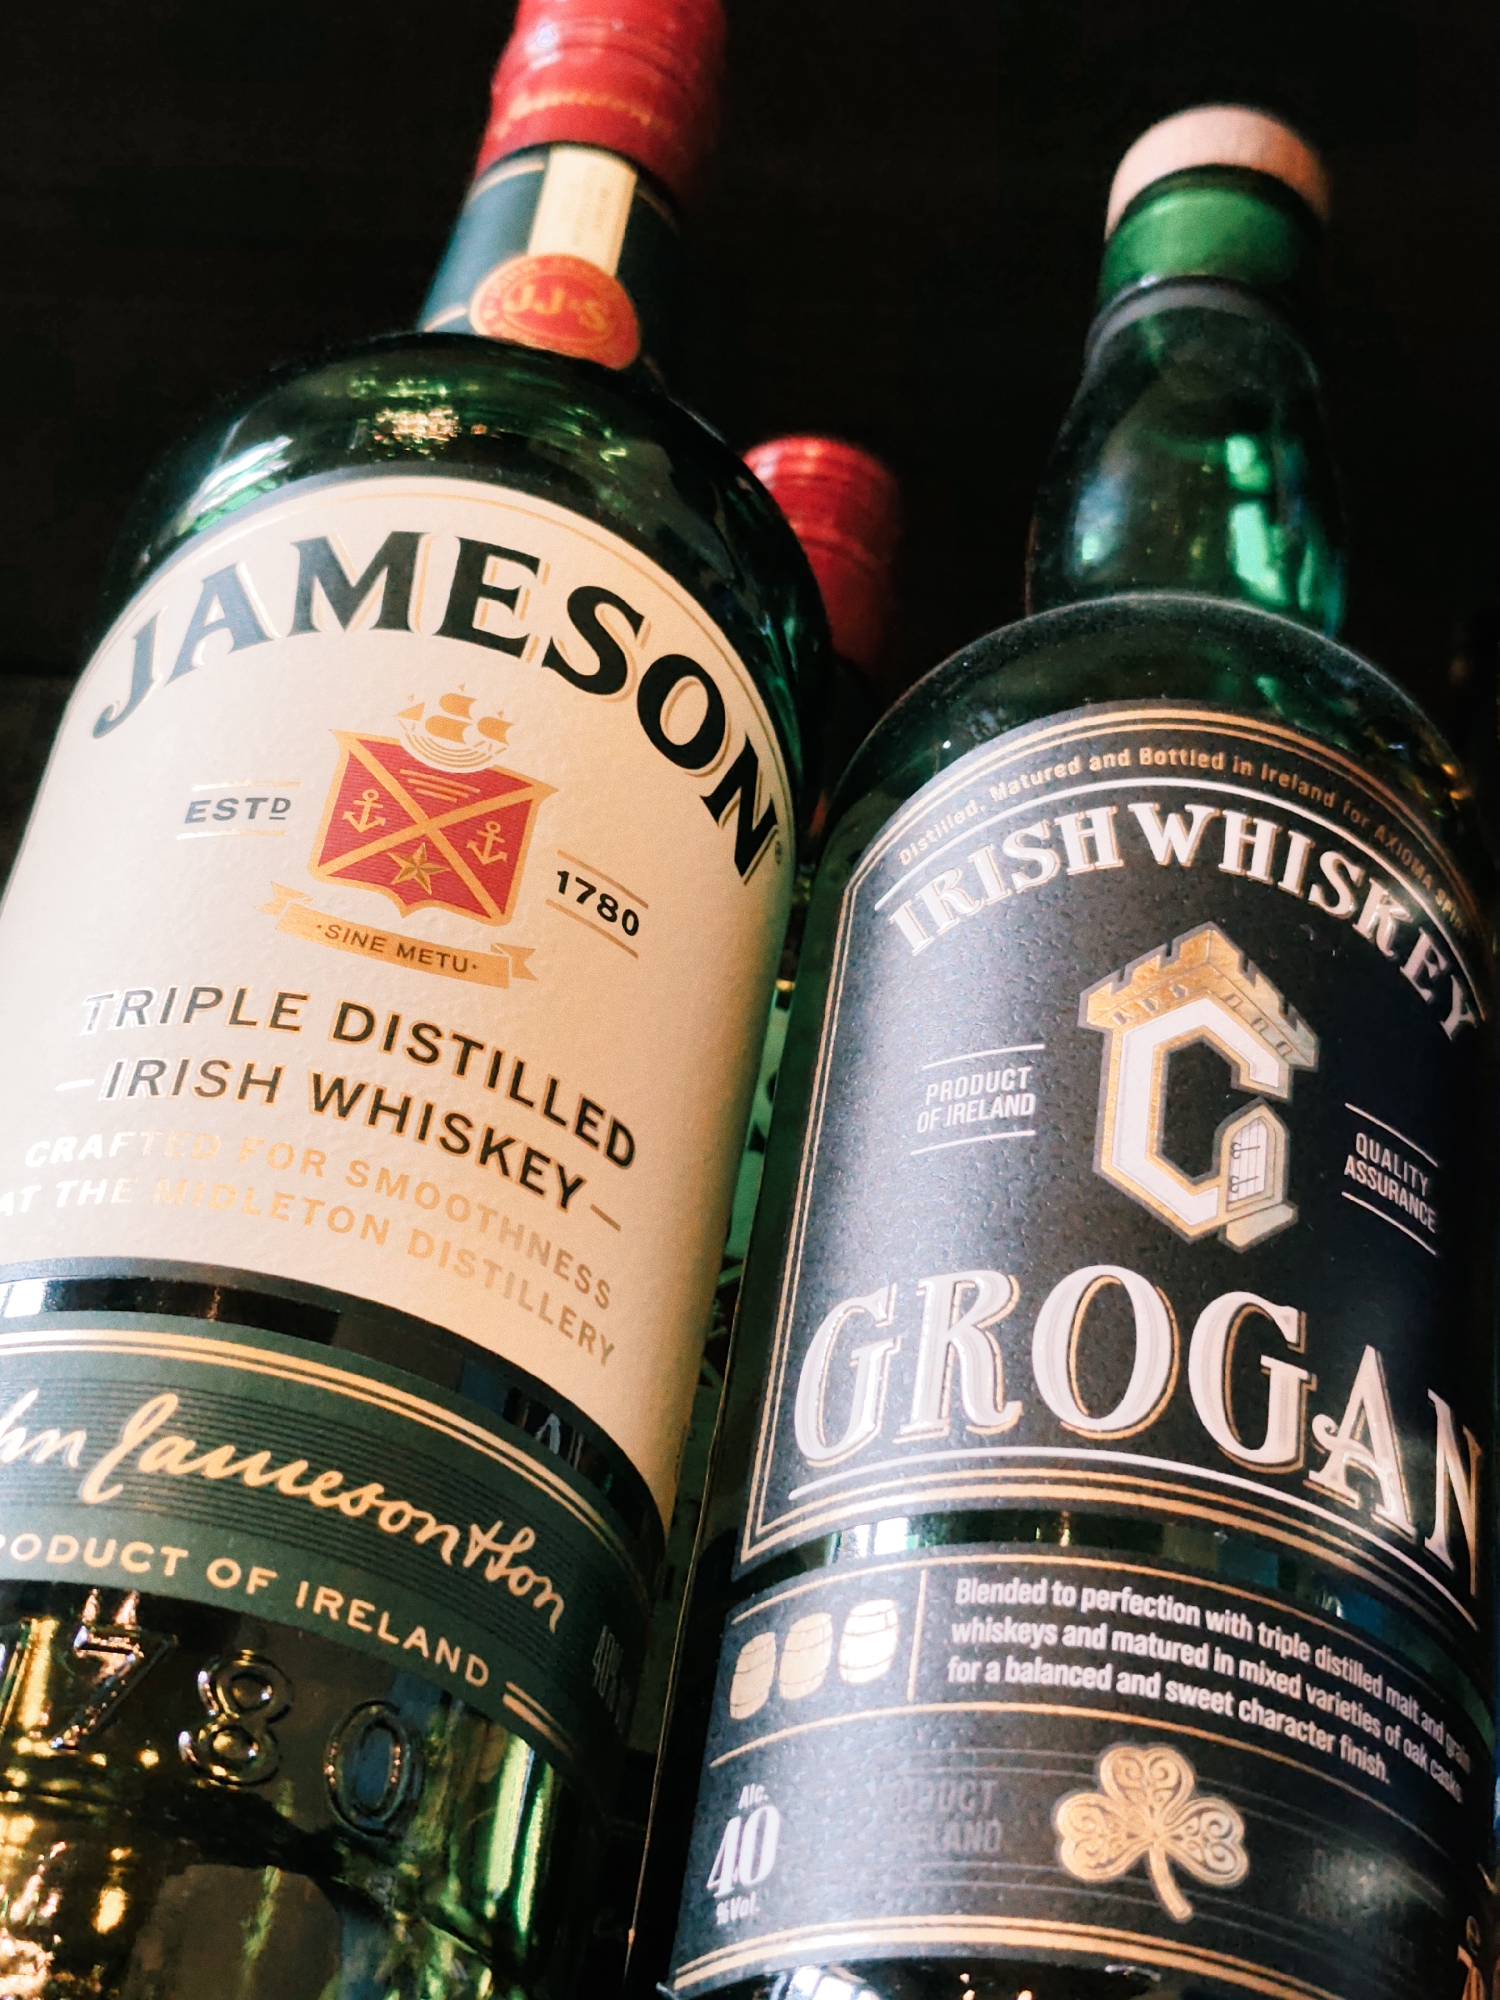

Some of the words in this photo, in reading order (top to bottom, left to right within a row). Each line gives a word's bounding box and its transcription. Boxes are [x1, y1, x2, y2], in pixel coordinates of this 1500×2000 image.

[92, 531, 780, 884] JAMESON
[184, 797, 291, 824] ESTD
[990, 756, 1082, 802] Matured
[1089, 748, 1131, 772] and
[1139, 746, 1226, 770] Bottled
[1232, 755, 1254, 776] in
[1260, 762, 1336, 808] Ireland
[1342, 800, 1371, 827] for
[556, 871, 640, 937] 1780
[888, 805, 1124, 957] IRISH
[1128, 803, 1477, 1040] WHISKEY
[82, 985, 310, 1036] TRIPLE
[332, 999, 638, 1171] DISTILLED
[100, 1057, 284, 1105] IRISH
[310, 1072, 586, 1212] WHISKEY
[916, 1107, 942, 1133] OF
[943, 1093, 1037, 1128] IRELAND
[925, 1066, 1033, 1106] PRODUCT
[25, 1131, 221, 1168] CRAFTED
[238, 1137, 328, 1178] FOR
[344, 1159, 612, 1310] SMOOTHNESS
[1343, 1154, 1436, 1233] ASSURANCE
[1355, 1132, 1428, 1197] QUALITY
[55, 1177, 138, 1208] THE
[152, 1177, 390, 1247] MIDLETON
[407, 1227, 617, 1370] DISTILLERY
[793, 1263, 1484, 1597] GROGAN
[0, 1533, 189, 1577] ODUCT
[206, 1557, 278, 1595] OF
[295, 1580, 490, 1687] IRELAND
[955, 1577, 1047, 1605] Blended
[1052, 1580, 1076, 1607] to
[1080, 1586, 1201, 1627] perfection
[1205, 1609, 1253, 1643] with
[1257, 1621, 1311, 1662] triple
[1314, 1645, 1384, 1700] distilled
[1386, 1684, 1420, 1726] malt
[1421, 1711, 1445, 1745] and
[947, 1655, 982, 1683] for
[984, 1659, 1001, 1684] a
[1004, 1655, 1113, 1691] balanced
[1116, 1671, 1162, 1699] and
[1165, 1679, 1235, 1718] sweet
[1238, 1698, 1336, 1754] character
[1339, 1733, 1391, 1786] finish.
[951, 1616, 1059, 1649] whiskeys
[1061, 1622, 1107, 1650] and
[1112, 1629, 1210, 1670] matured
[1213, 1646, 1235, 1676] in
[1238, 1656, 1301, 1699] mixed
[1305, 1682, 1381, 1739] varieties
[1384, 1724, 1402, 1751] of
[1402, 1737, 1429, 1771] oak
[706, 1805, 780, 1898] 40
[738, 1782, 769, 1810] Alc.
